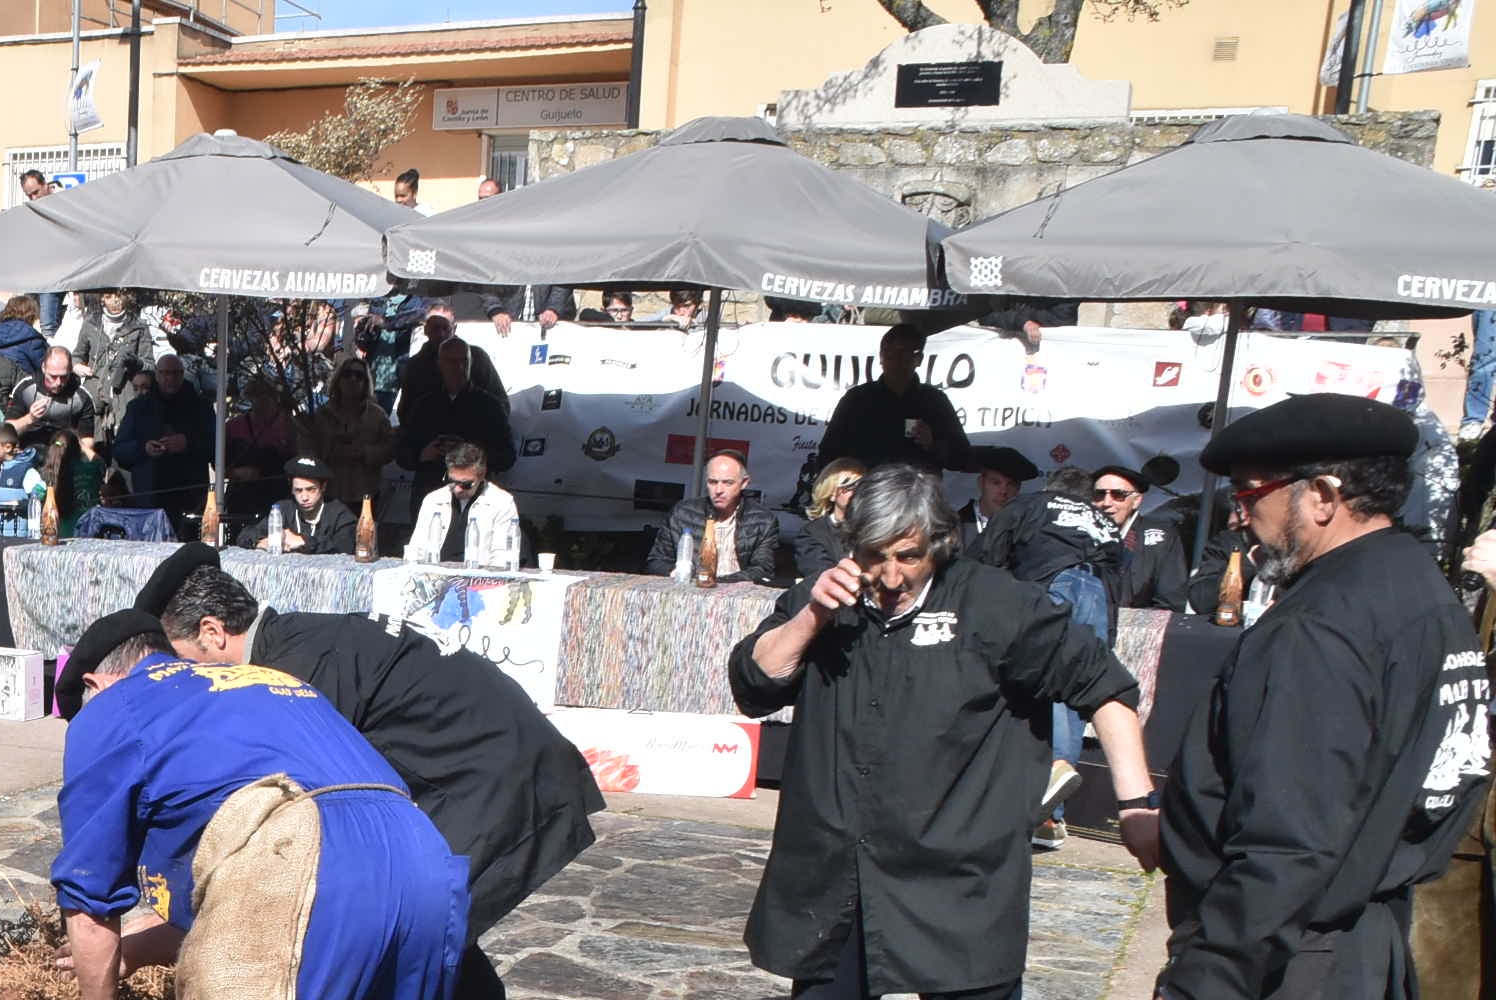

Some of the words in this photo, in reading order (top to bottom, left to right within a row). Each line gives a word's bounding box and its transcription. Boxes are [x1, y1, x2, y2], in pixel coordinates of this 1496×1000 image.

[505, 88, 554, 102] CENTRO
[560, 87, 576, 101] DE
[579, 86, 620, 100] SALUD
[540, 107, 583, 121] Guijuelo
[199, 267, 279, 292] CERVEZAS
[285, 271, 377, 293] ALHAMBRA
[760, 272, 856, 303] CERVEZAS
[860, 284, 968, 307] ALHAMBRA
[771, 352, 975, 390] GUIJLO
[686, 398, 788, 424] JRNADAS
[795, 409, 818, 426] DE
